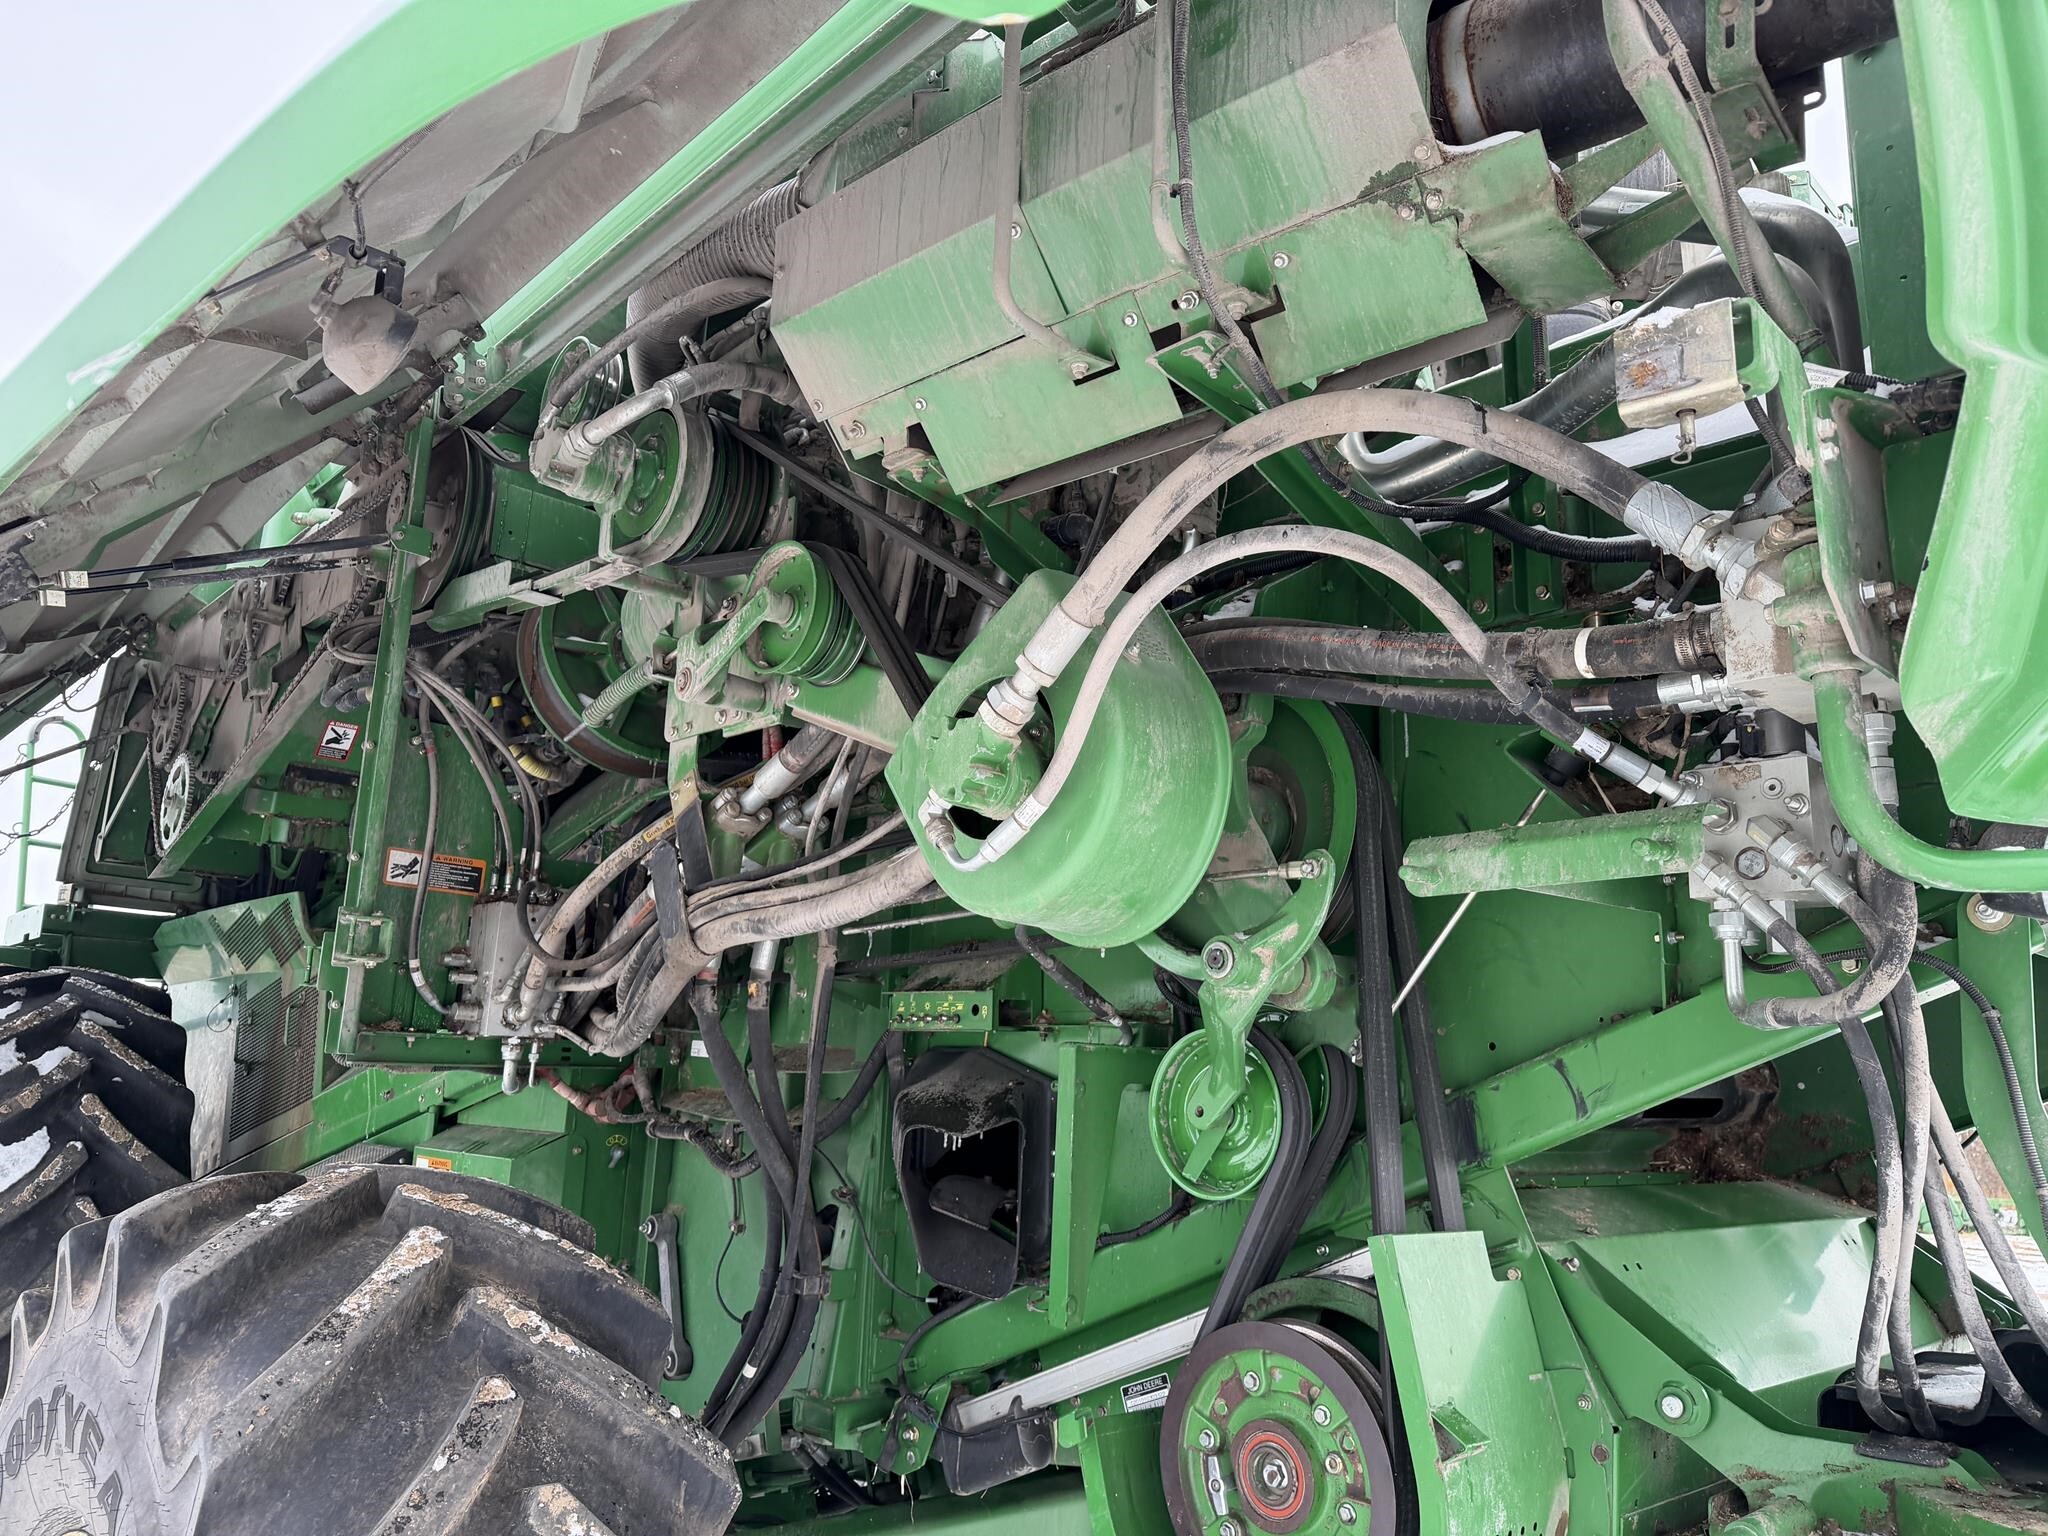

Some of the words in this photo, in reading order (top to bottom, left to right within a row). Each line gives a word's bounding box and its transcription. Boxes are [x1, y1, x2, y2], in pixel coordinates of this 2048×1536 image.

[335, 721, 359, 730] DANGER
[443, 857, 473, 865] WARNING
[1127, 1382, 1143, 1394] JOHN
[1143, 1377, 1163, 1390] DEERE
